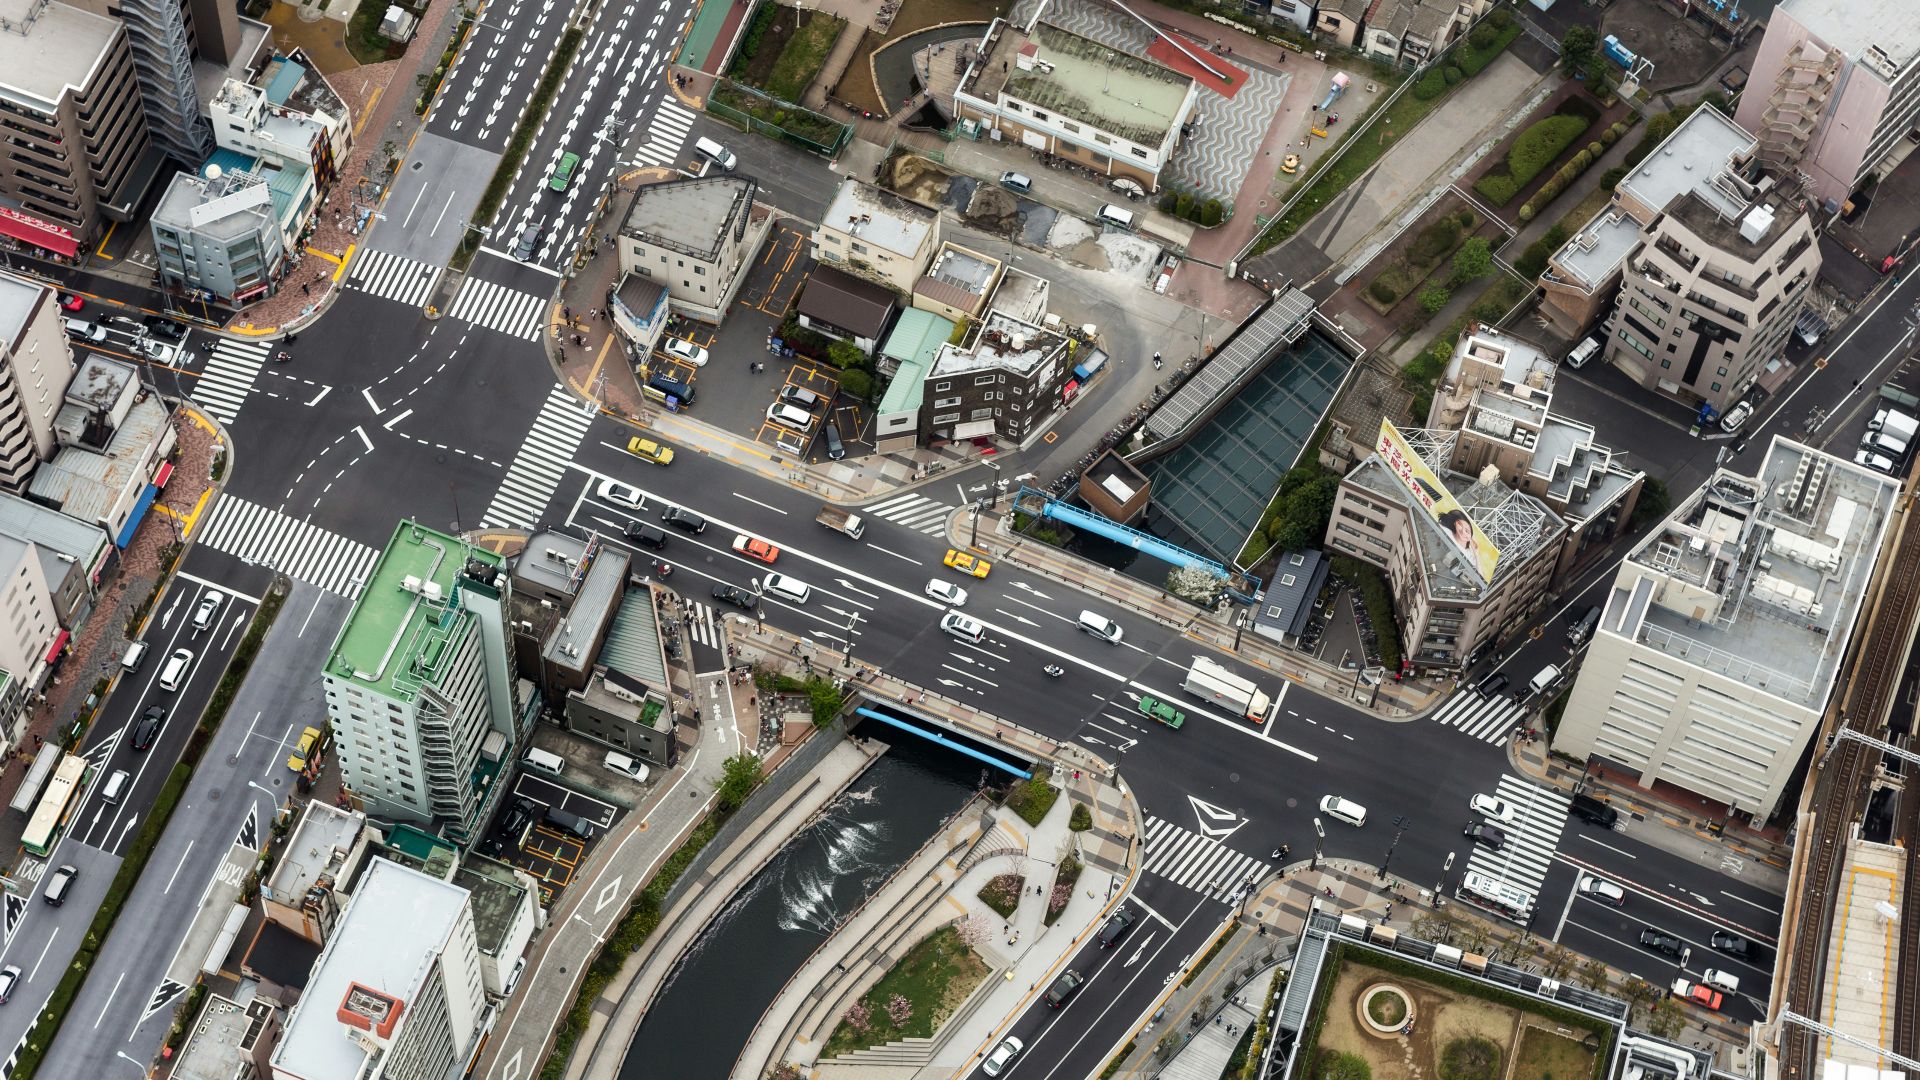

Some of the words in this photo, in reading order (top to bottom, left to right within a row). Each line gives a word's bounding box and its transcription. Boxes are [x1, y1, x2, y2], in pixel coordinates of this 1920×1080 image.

[1383, 436, 1412, 473] 東芝の
[1381, 445, 1432, 509] 太陽光発電
[16, 857, 46, 882] バス停
[217, 862, 248, 888] バス停
